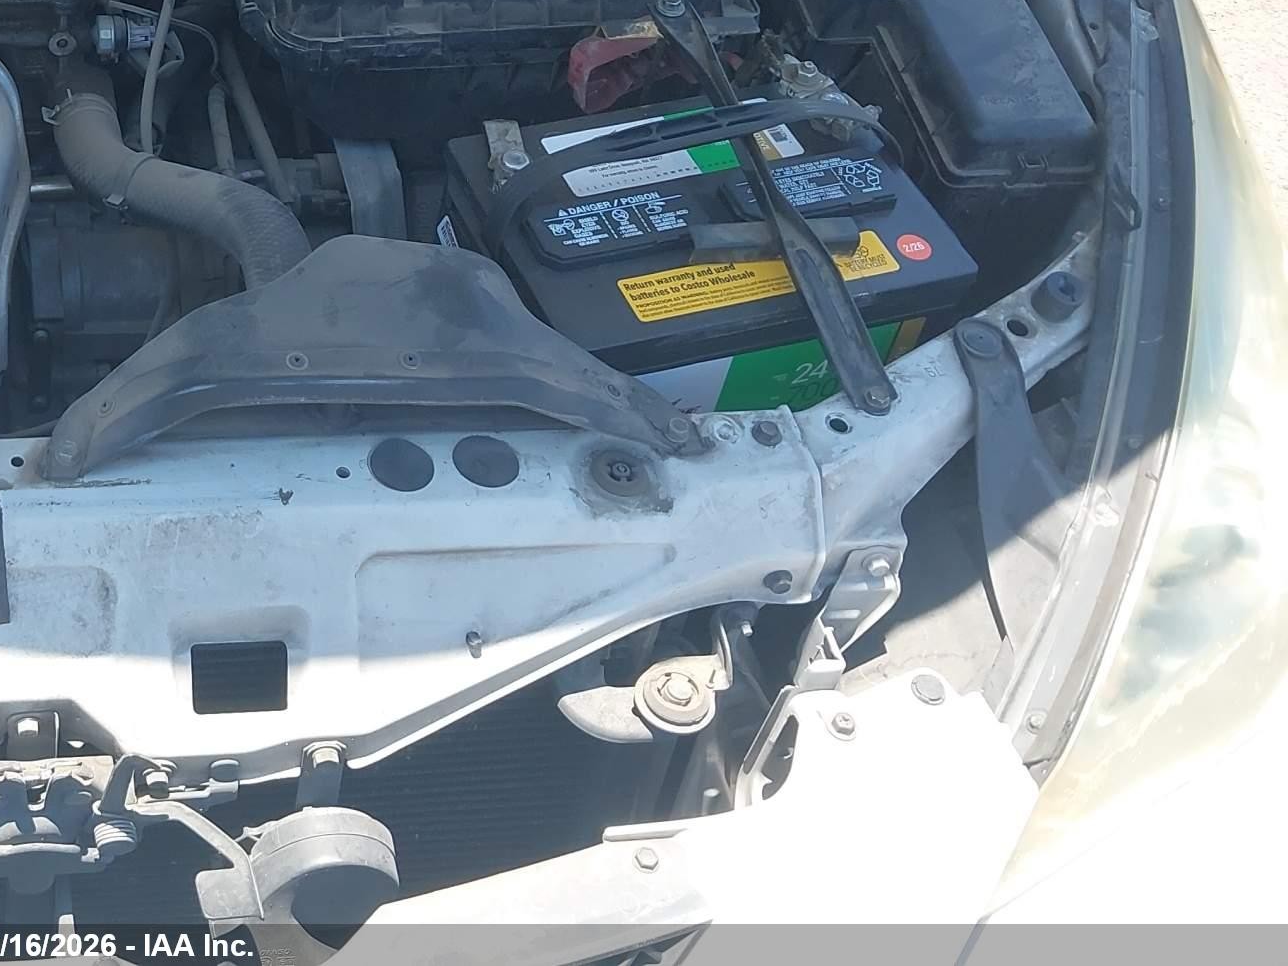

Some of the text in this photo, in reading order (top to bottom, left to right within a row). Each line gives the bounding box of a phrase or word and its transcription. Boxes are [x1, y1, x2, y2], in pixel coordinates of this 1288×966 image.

[568, 201, 612, 215] DANGER
[621, 192, 660, 205] POISON
[903, 242, 925, 252] 2/26
[623, 263, 735, 291] Return warranty and used
[630, 270, 756, 301] batteries to Costco Wholesale
